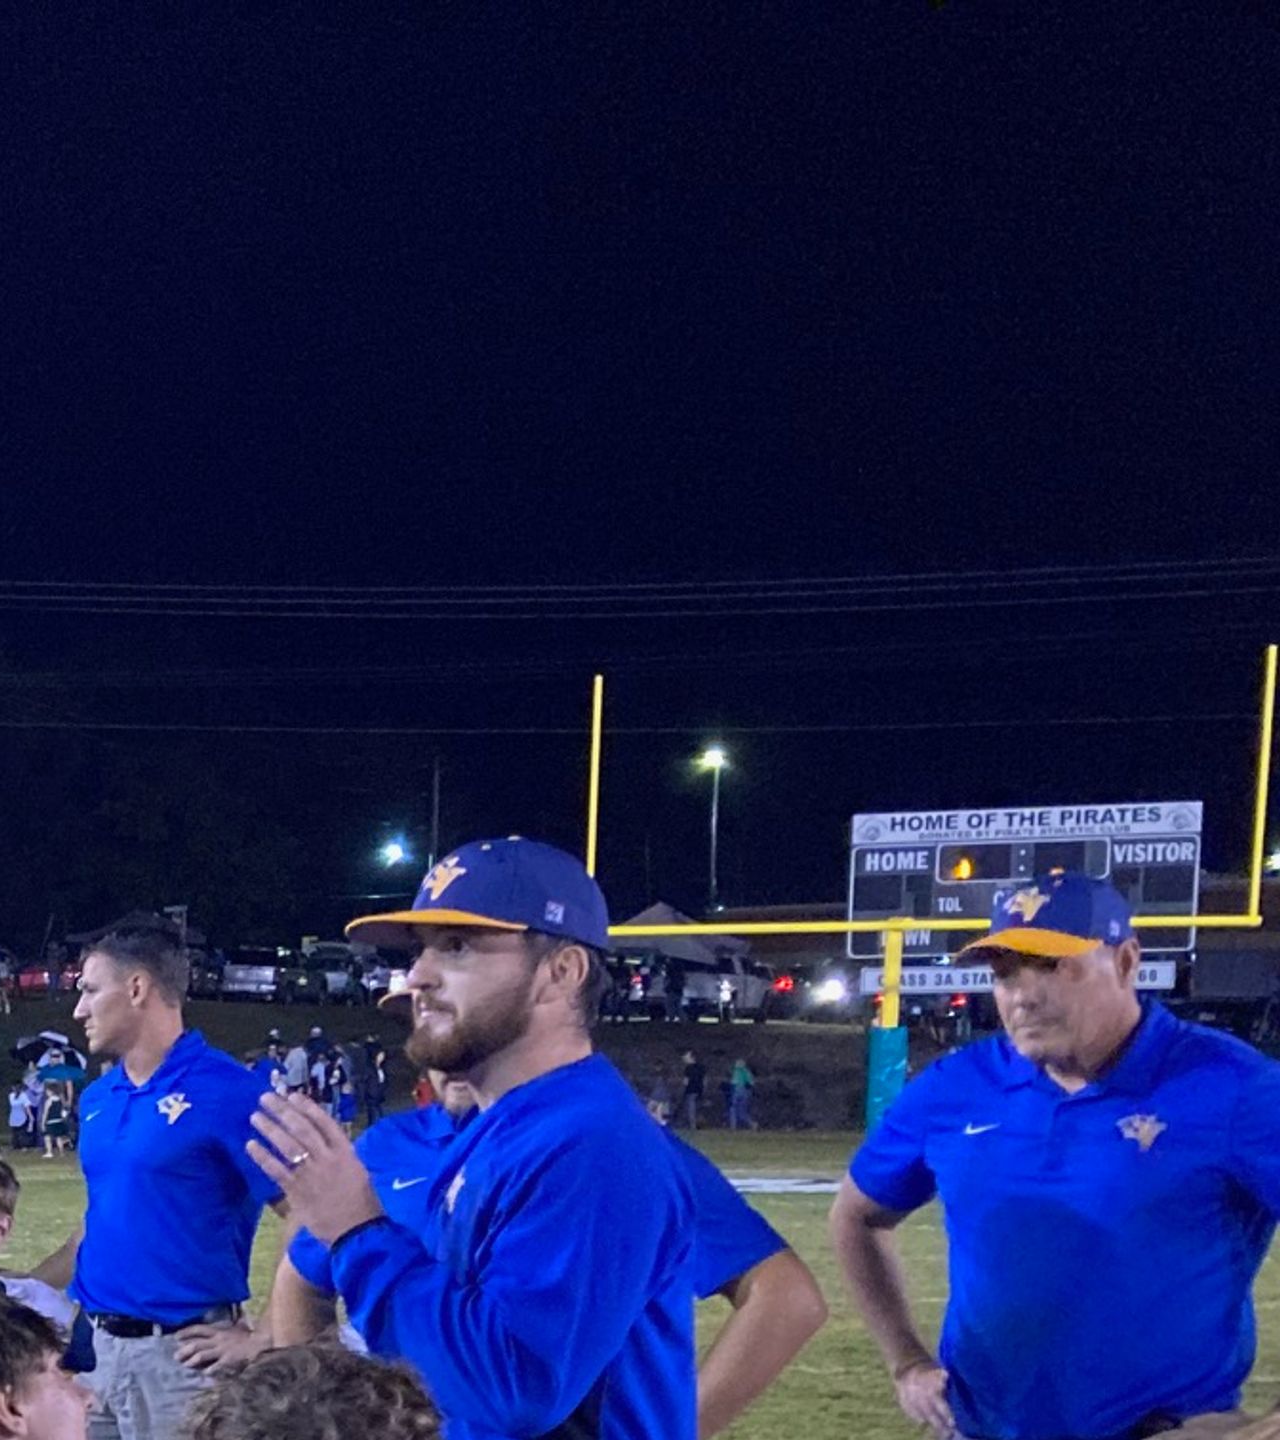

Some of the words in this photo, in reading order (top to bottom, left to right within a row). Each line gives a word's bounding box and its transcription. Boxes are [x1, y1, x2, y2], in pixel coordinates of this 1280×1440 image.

[891, 814, 959, 832] HOME
[967, 811, 996, 829] OF
[1004, 810, 1052, 827] THE
[1059, 807, 1162, 825] PIRATES
[918, 830, 973, 840] DONATED
[975, 829, 992, 838] BY
[994, 828, 1037, 838] PIRATE
[1040, 826, 1092, 836] ATHLETIC
[1095, 824, 1131, 833] CLUB
[864, 851, 929, 871] HOME
[1113, 842, 1195, 863] VISITOR
[938, 897, 963, 912] TOL
[878, 971, 928, 988] ASS
[933, 971, 954, 987] 3A
